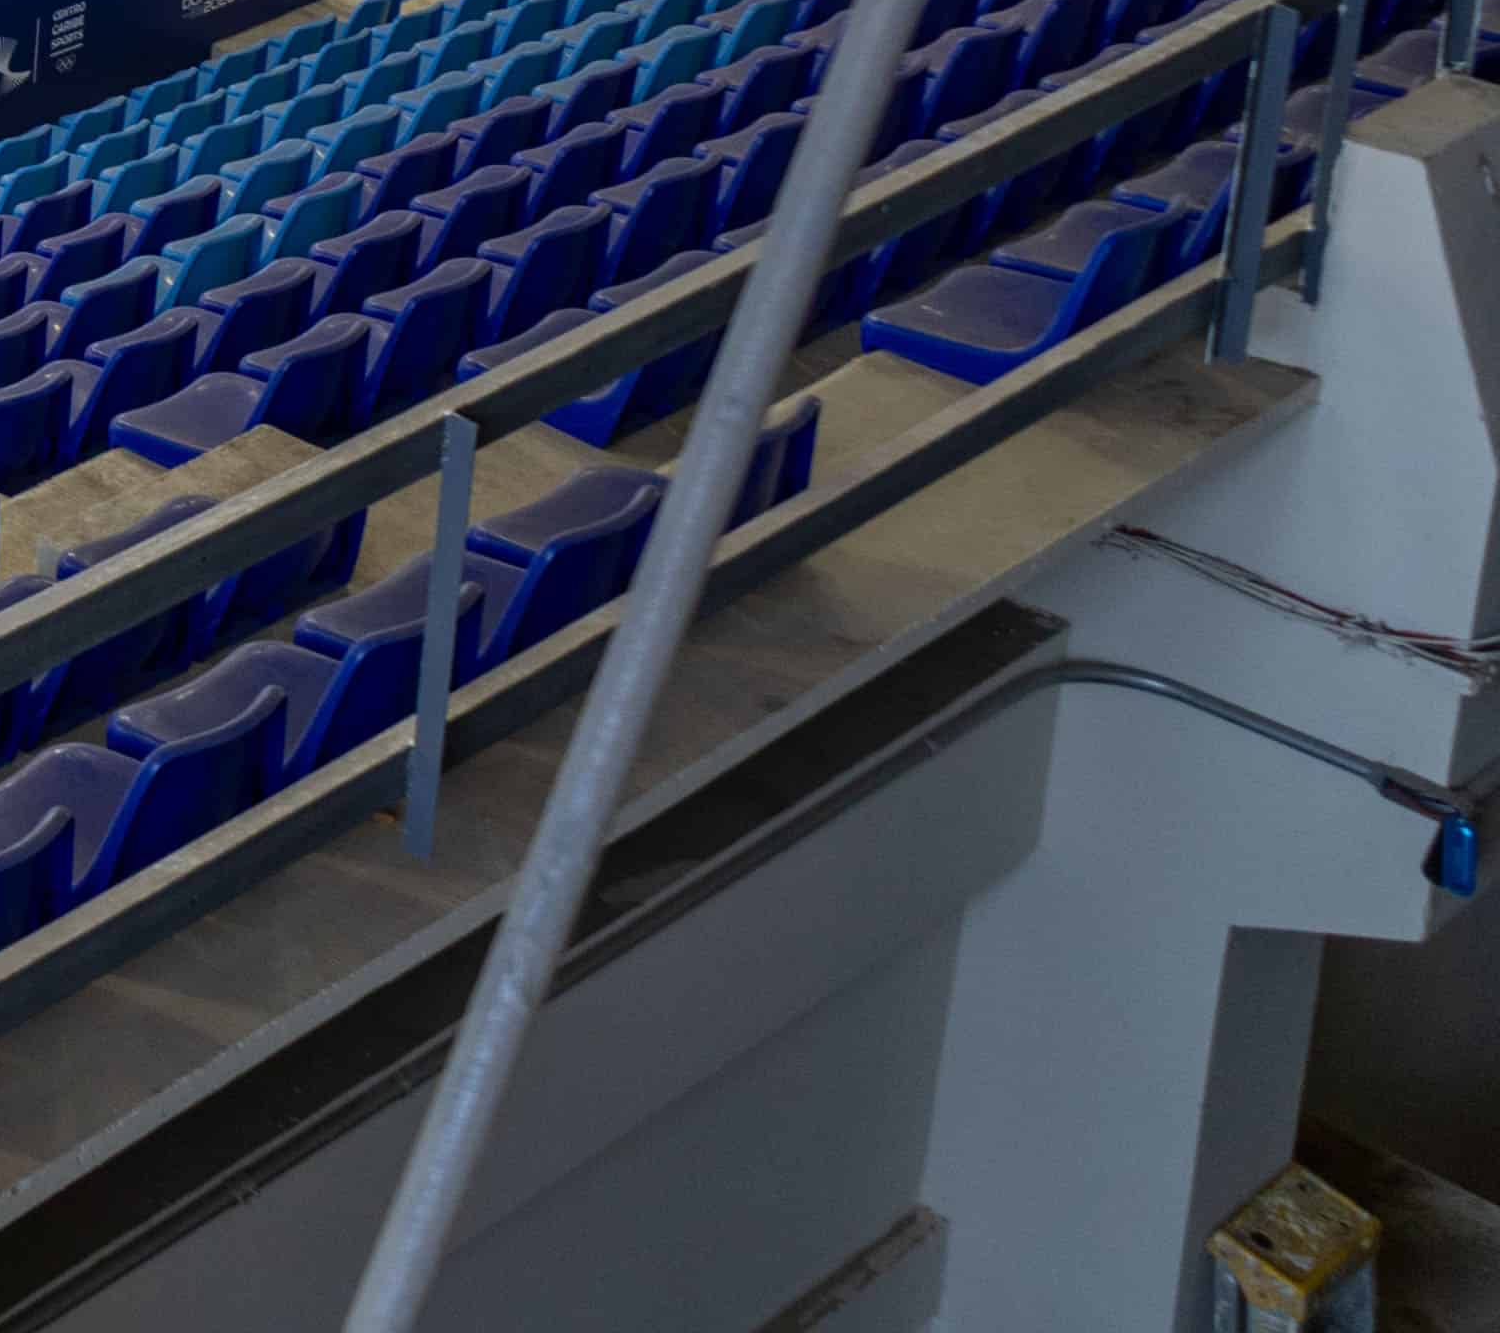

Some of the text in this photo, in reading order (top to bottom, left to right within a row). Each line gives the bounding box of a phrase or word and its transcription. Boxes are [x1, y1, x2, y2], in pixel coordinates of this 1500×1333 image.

[53, 1, 86, 22] CENTRO
[52, 13, 86, 36] CARIBE
[51, 29, 84, 50] SPORTS
